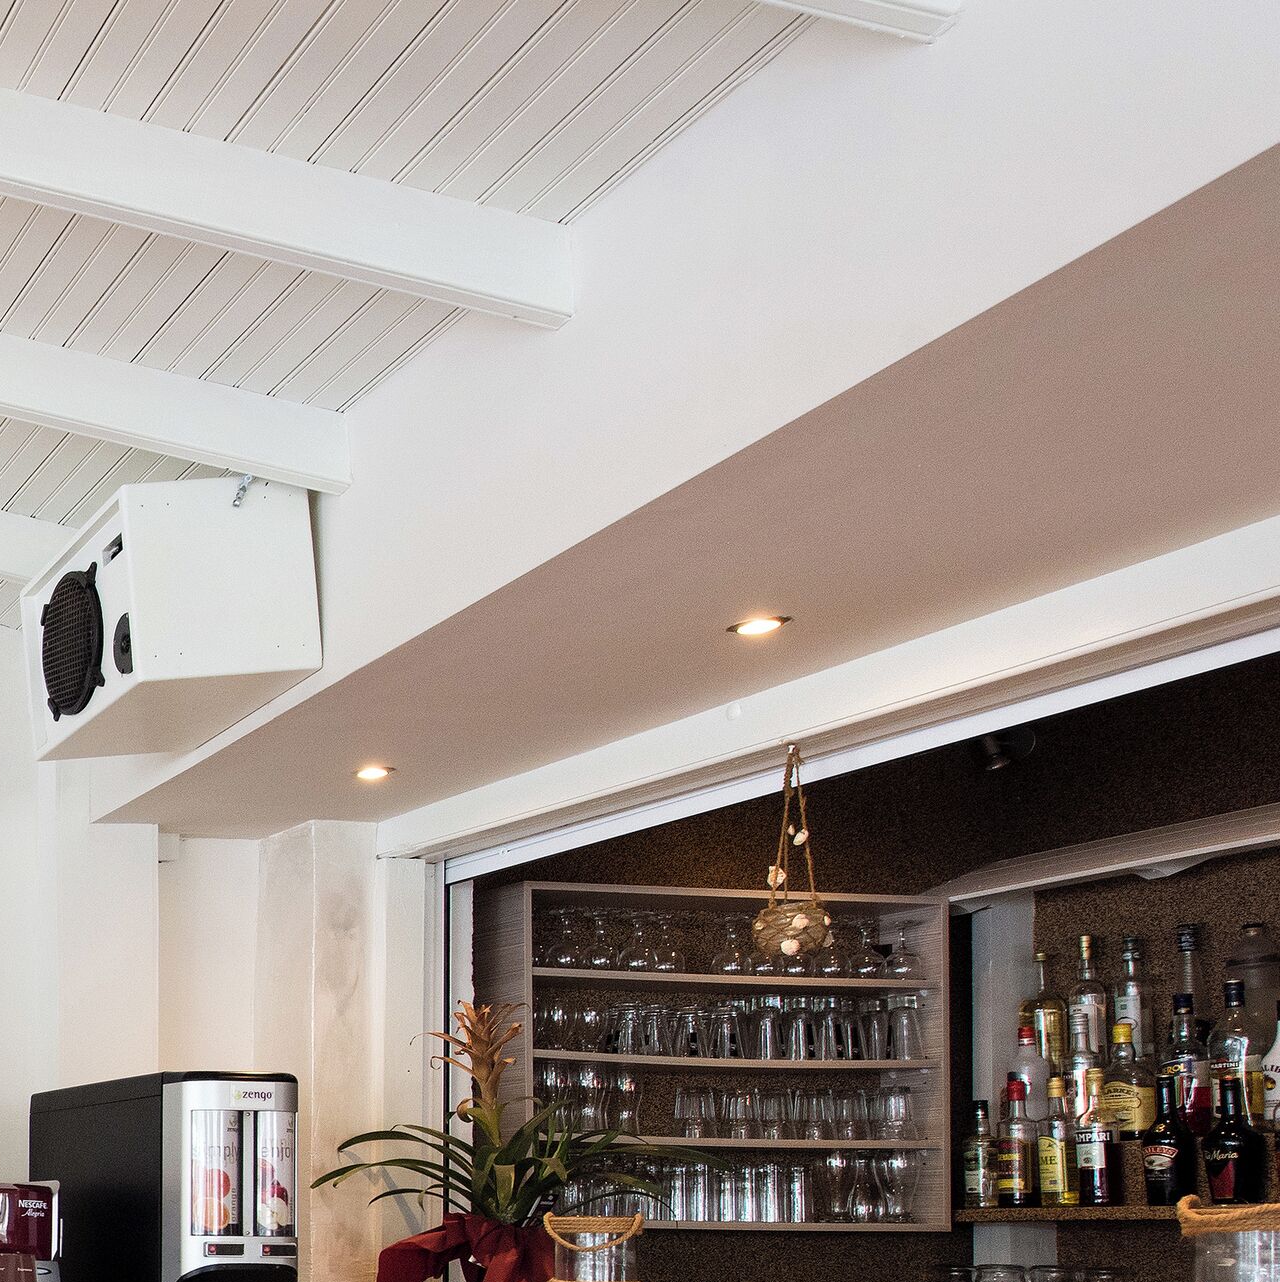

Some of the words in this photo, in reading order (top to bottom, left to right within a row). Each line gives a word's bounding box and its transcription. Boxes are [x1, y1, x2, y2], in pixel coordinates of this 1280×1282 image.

[242, 1089, 272, 1101] zengo
[1075, 1131, 1110, 1144] AMPARI
[261, 1142, 291, 1161] enjo
[1144, 1147, 1175, 1155] AILEYS
